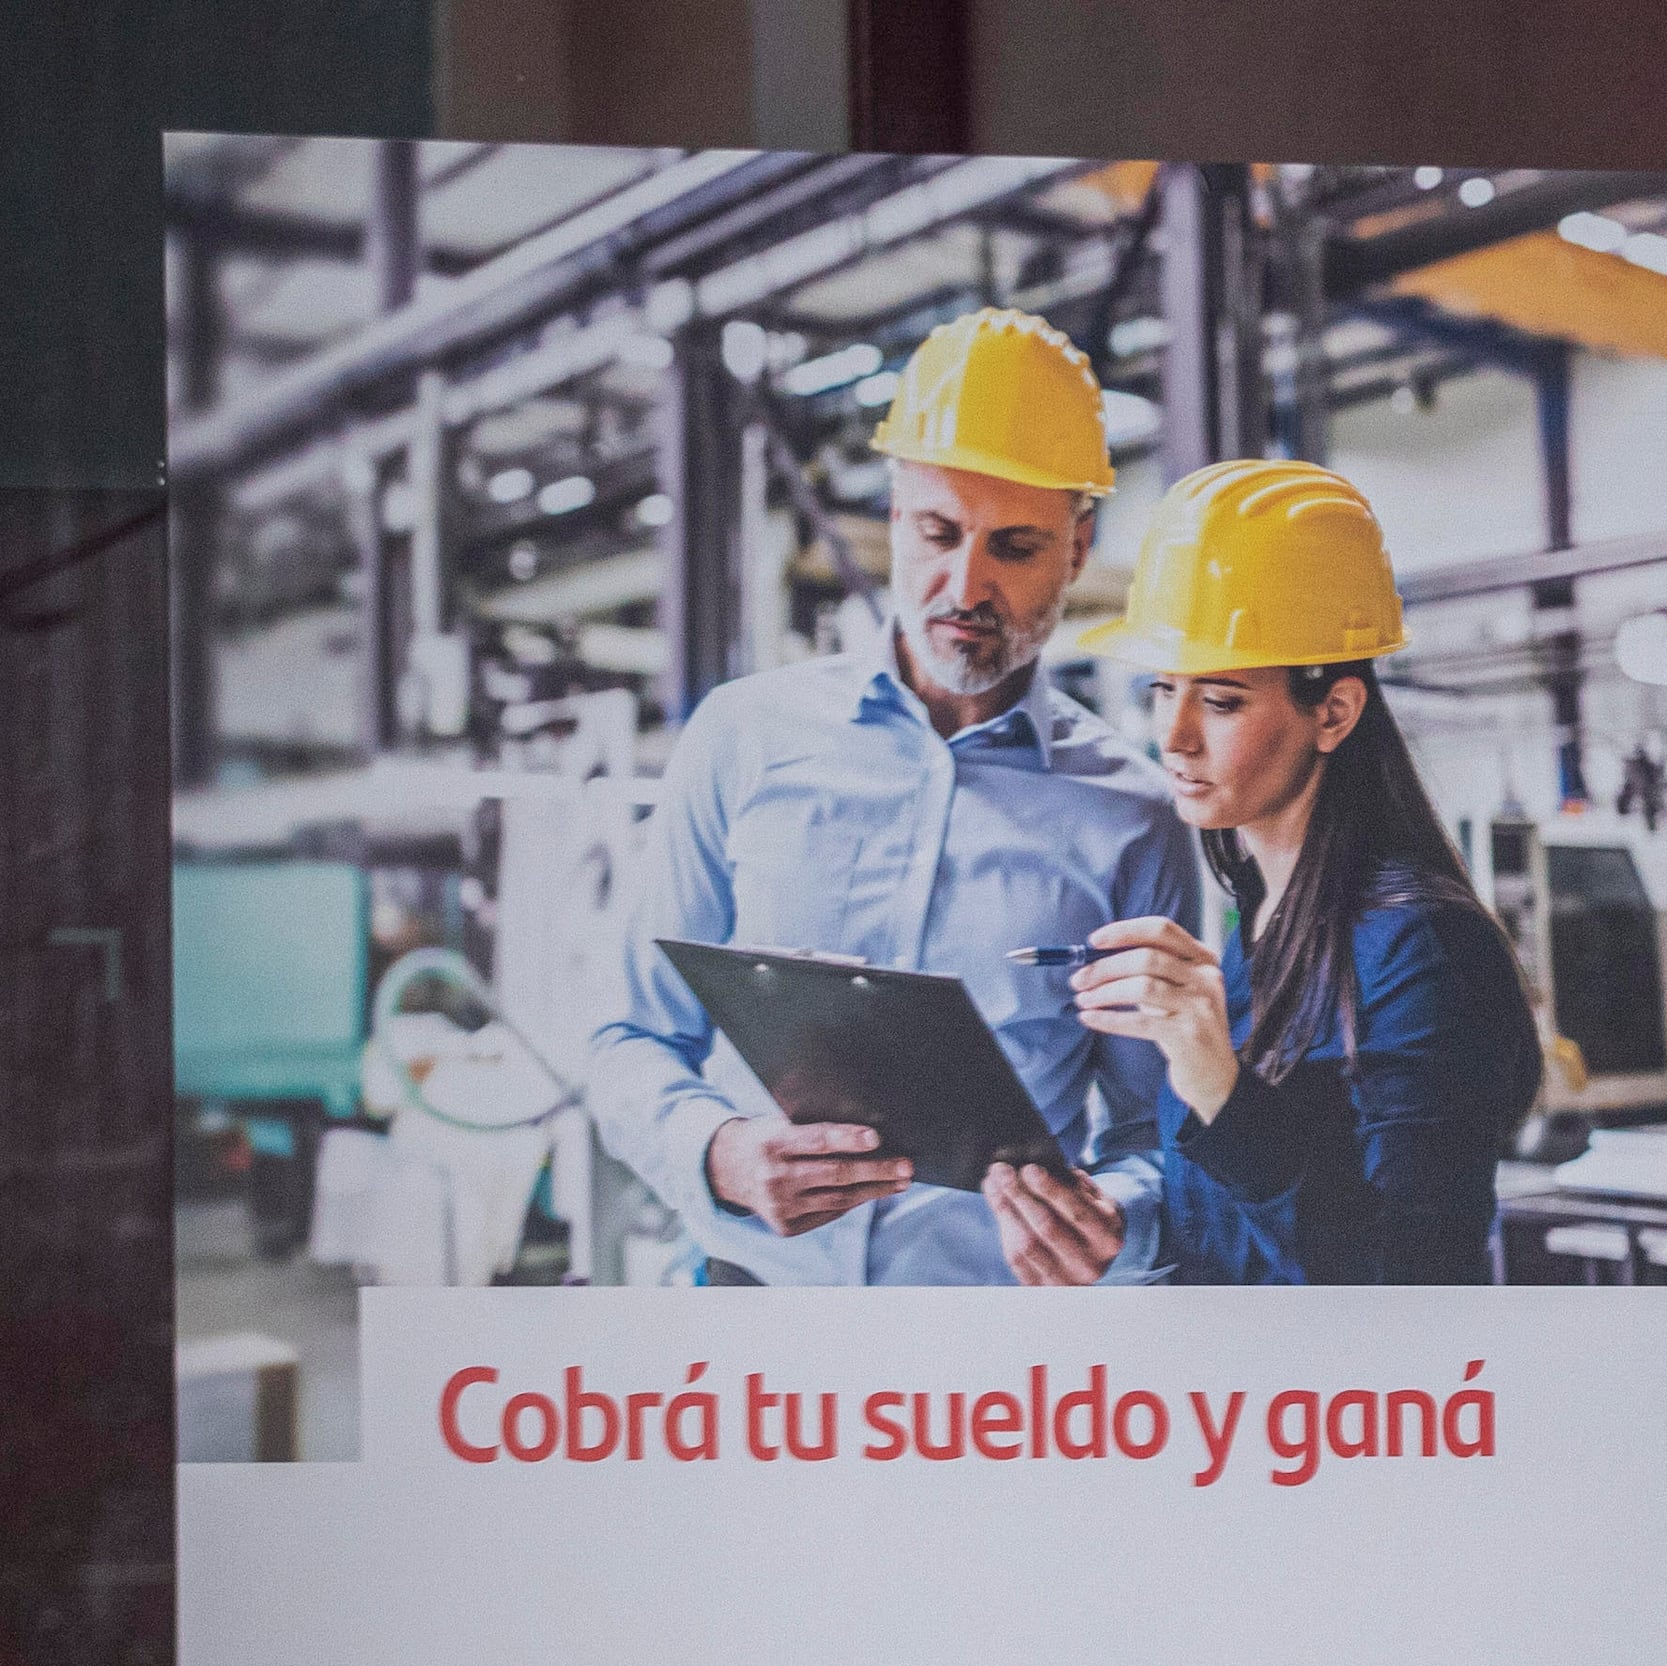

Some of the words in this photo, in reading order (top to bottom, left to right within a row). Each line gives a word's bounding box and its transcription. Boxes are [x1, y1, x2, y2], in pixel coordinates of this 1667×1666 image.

[437, 1361, 720, 1464] Cobrá
[745, 1373, 840, 1462] tu
[862, 1363, 1170, 1462] sueldo
[1186, 1389, 1247, 1488] y
[1266, 1360, 1497, 1487] ganá
